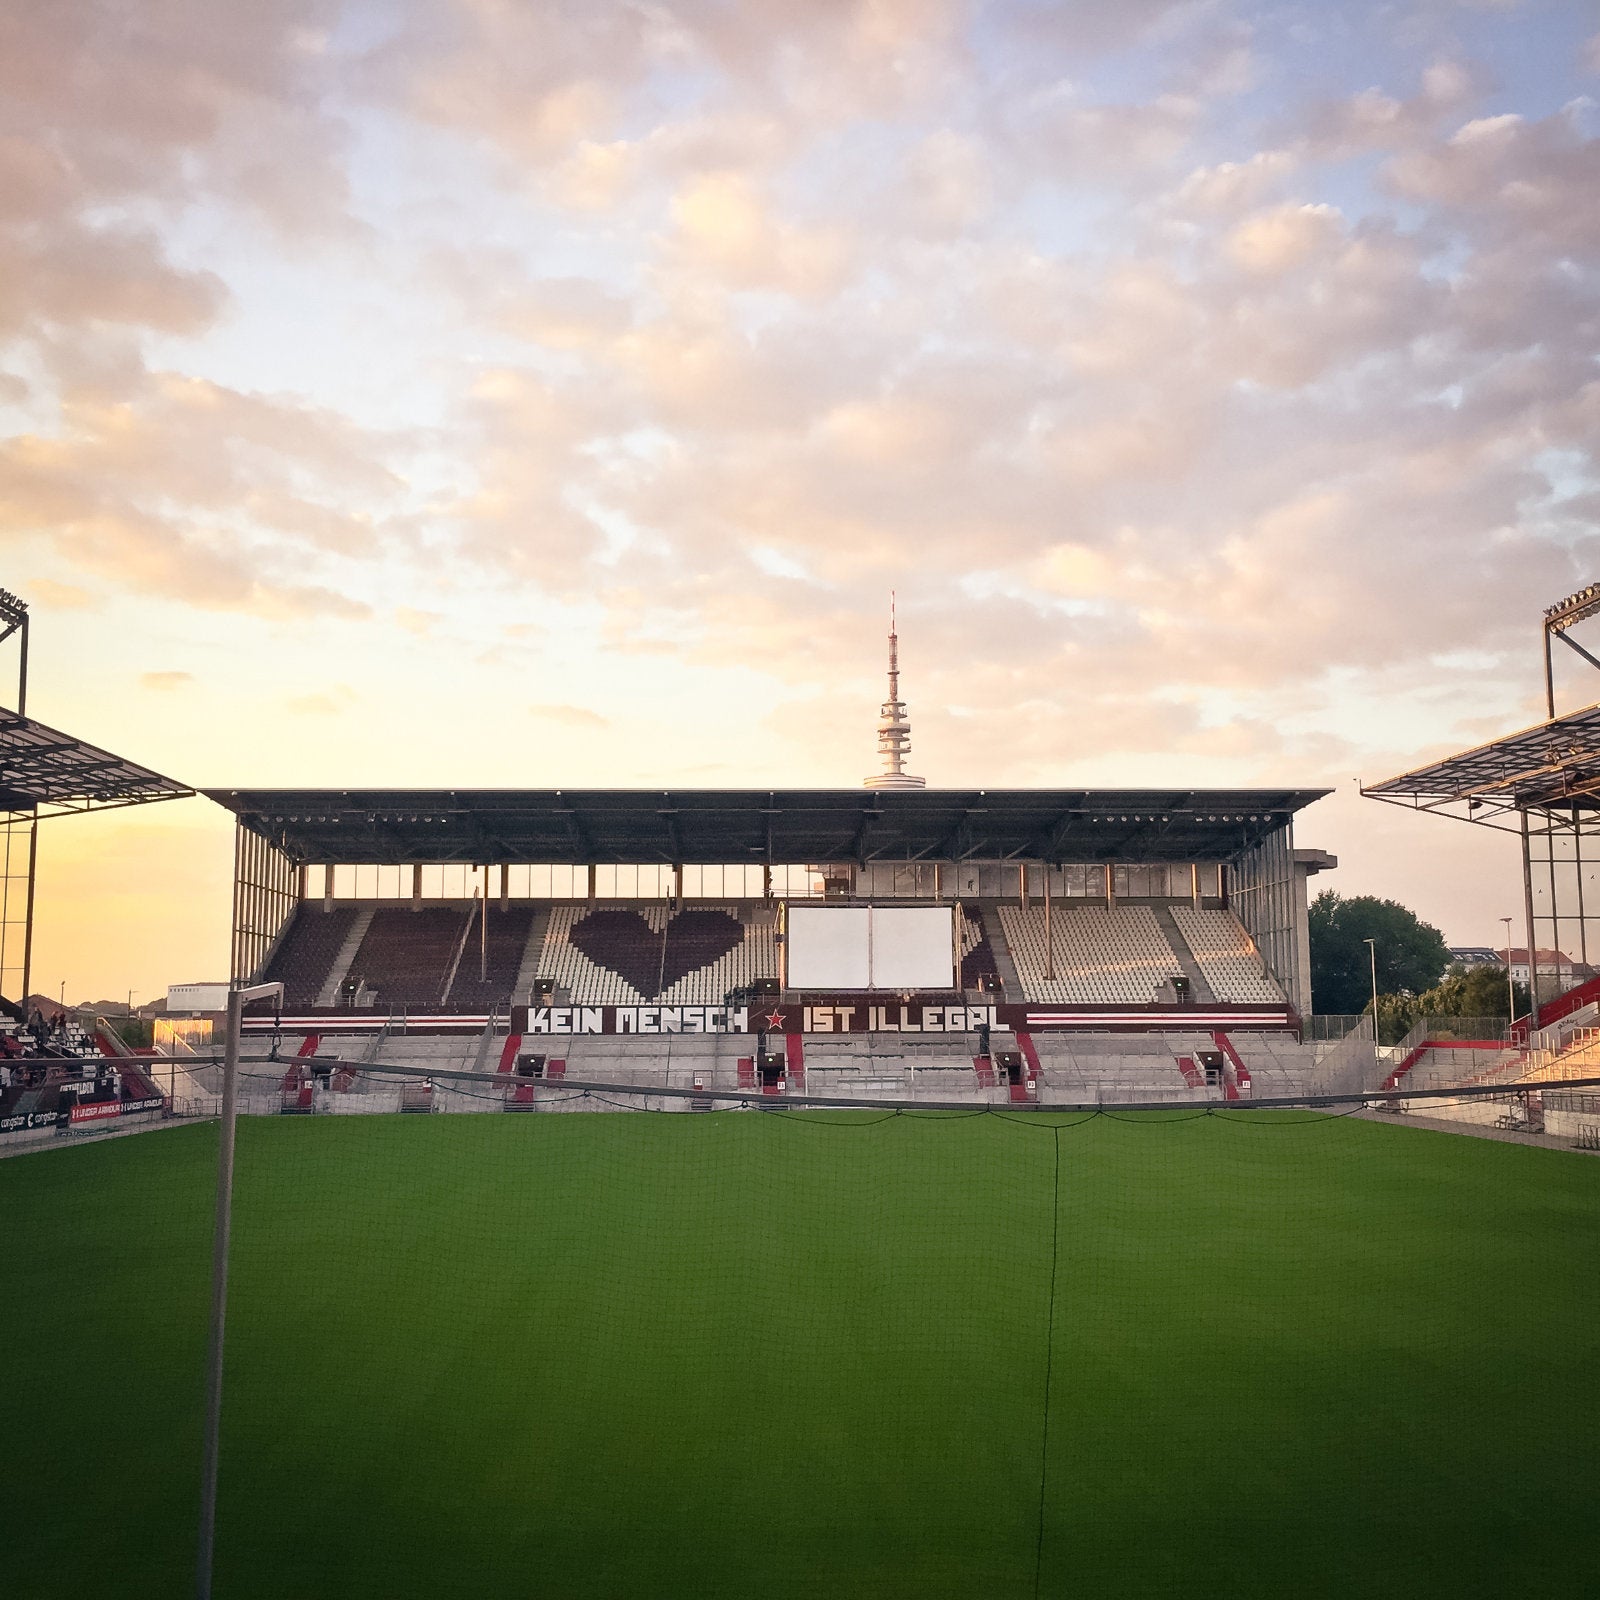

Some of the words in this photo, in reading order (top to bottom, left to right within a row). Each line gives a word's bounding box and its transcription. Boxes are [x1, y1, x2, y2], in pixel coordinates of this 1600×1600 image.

[528, 1007, 602, 1034] KEIN
[616, 1007, 748, 1033] MENSCH
[804, 1006, 855, 1032] IST
[869, 1006, 1010, 1032] ILLEGAL
[80, 1107, 98, 1118] UNDER
